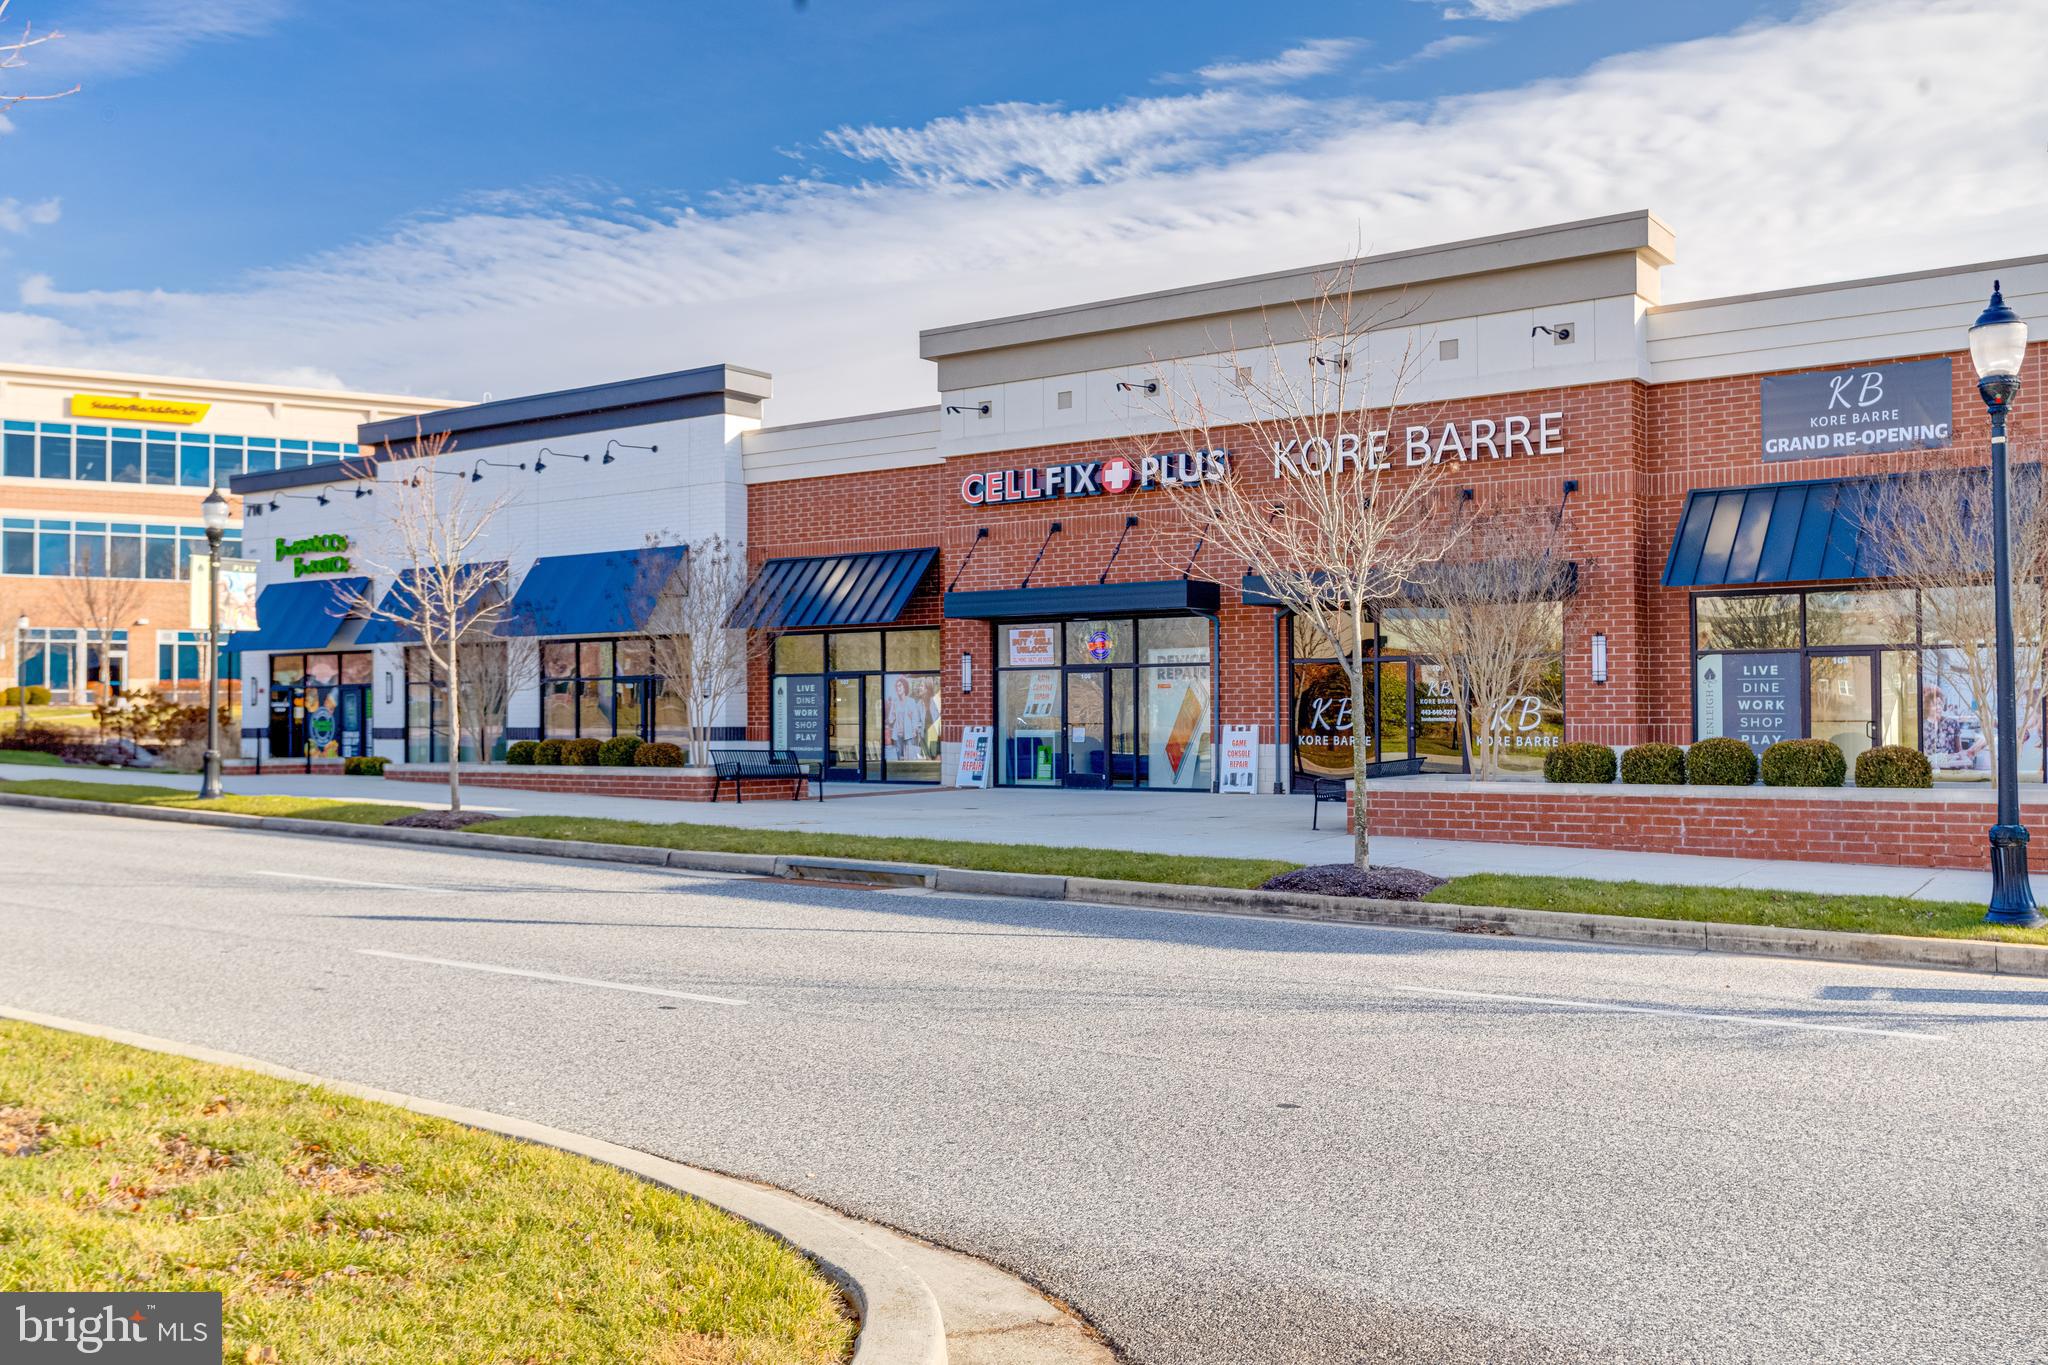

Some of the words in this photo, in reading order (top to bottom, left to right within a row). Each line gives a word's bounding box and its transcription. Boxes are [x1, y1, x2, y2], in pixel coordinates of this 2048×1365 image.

[1828, 371, 1883, 410] KB
[1810, 414, 1847, 428] KORE
[1852, 409, 1899, 424] BARRE
[1765, 434, 1830, 454] GRAND
[1833, 423, 1948, 448] RE-OPENING
[1273, 430, 1391, 479] KORE
[1405, 411, 1565, 467] BARRE
[1141, 450, 1226, 487] PLUS
[1157, 667, 1207, 681] REPAIR
[1743, 665, 1779, 676] LIVE
[796, 684, 816, 692] LIVE
[1742, 682, 1780, 693] DINE
[796, 697, 816, 705] DINE
[1738, 700, 1785, 710] WORK
[794, 709, 819, 717] WORK
[794, 721, 818, 729] SHOP
[1740, 717, 1783, 728] SHOP
[795, 733, 817, 741] PLAY
[1298, 735, 1329, 746] KORE
[1333, 735, 1371, 746] BARE
[1516, 736, 1559, 747] BARRE
[1741, 735, 1782, 745] PLAY
[1231, 739, 1247, 747] GAME
[1227, 750, 1251, 758] CONSOLE
[1229, 760, 1249, 768] REPAIR
